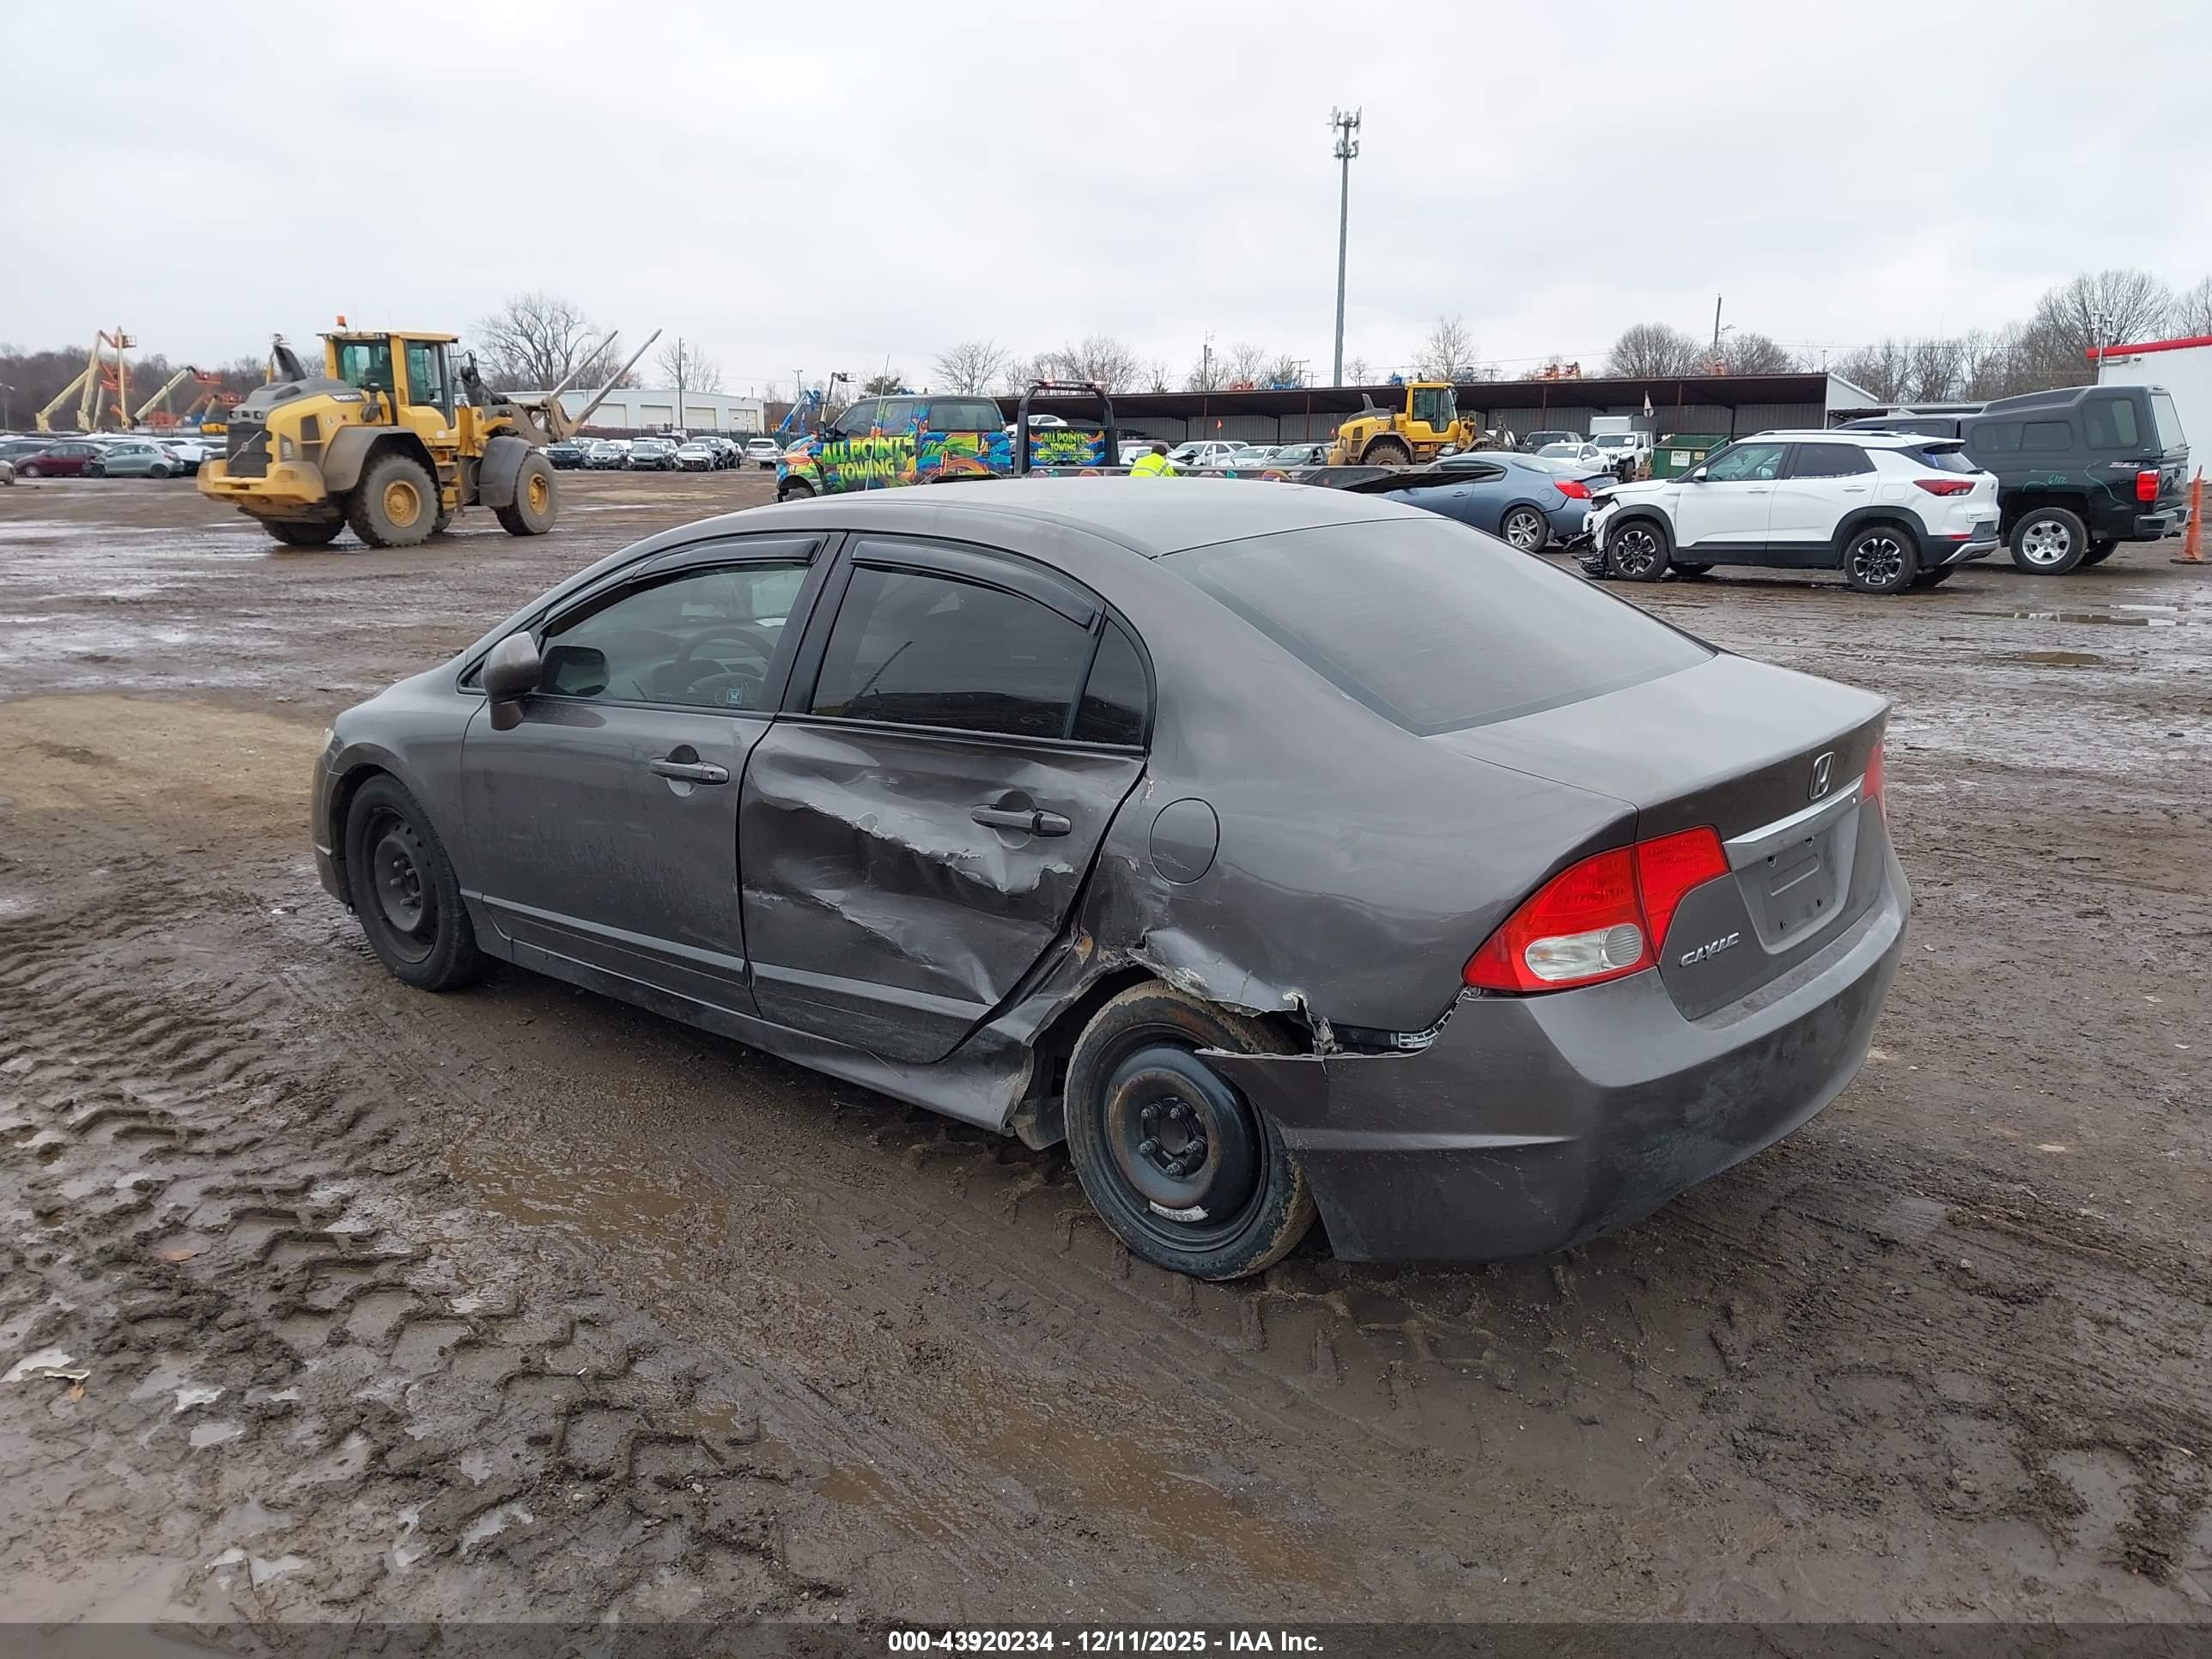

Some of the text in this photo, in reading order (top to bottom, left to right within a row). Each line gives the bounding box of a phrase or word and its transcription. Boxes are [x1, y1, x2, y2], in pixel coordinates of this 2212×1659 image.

[822, 433, 915, 465] ALL POINTS
[1043, 432, 1086, 443] ALL POINTS
[1049, 442, 1077, 452] TOWING
[837, 457, 896, 481] TOWING
[1680, 932, 1740, 967] CIVIC
